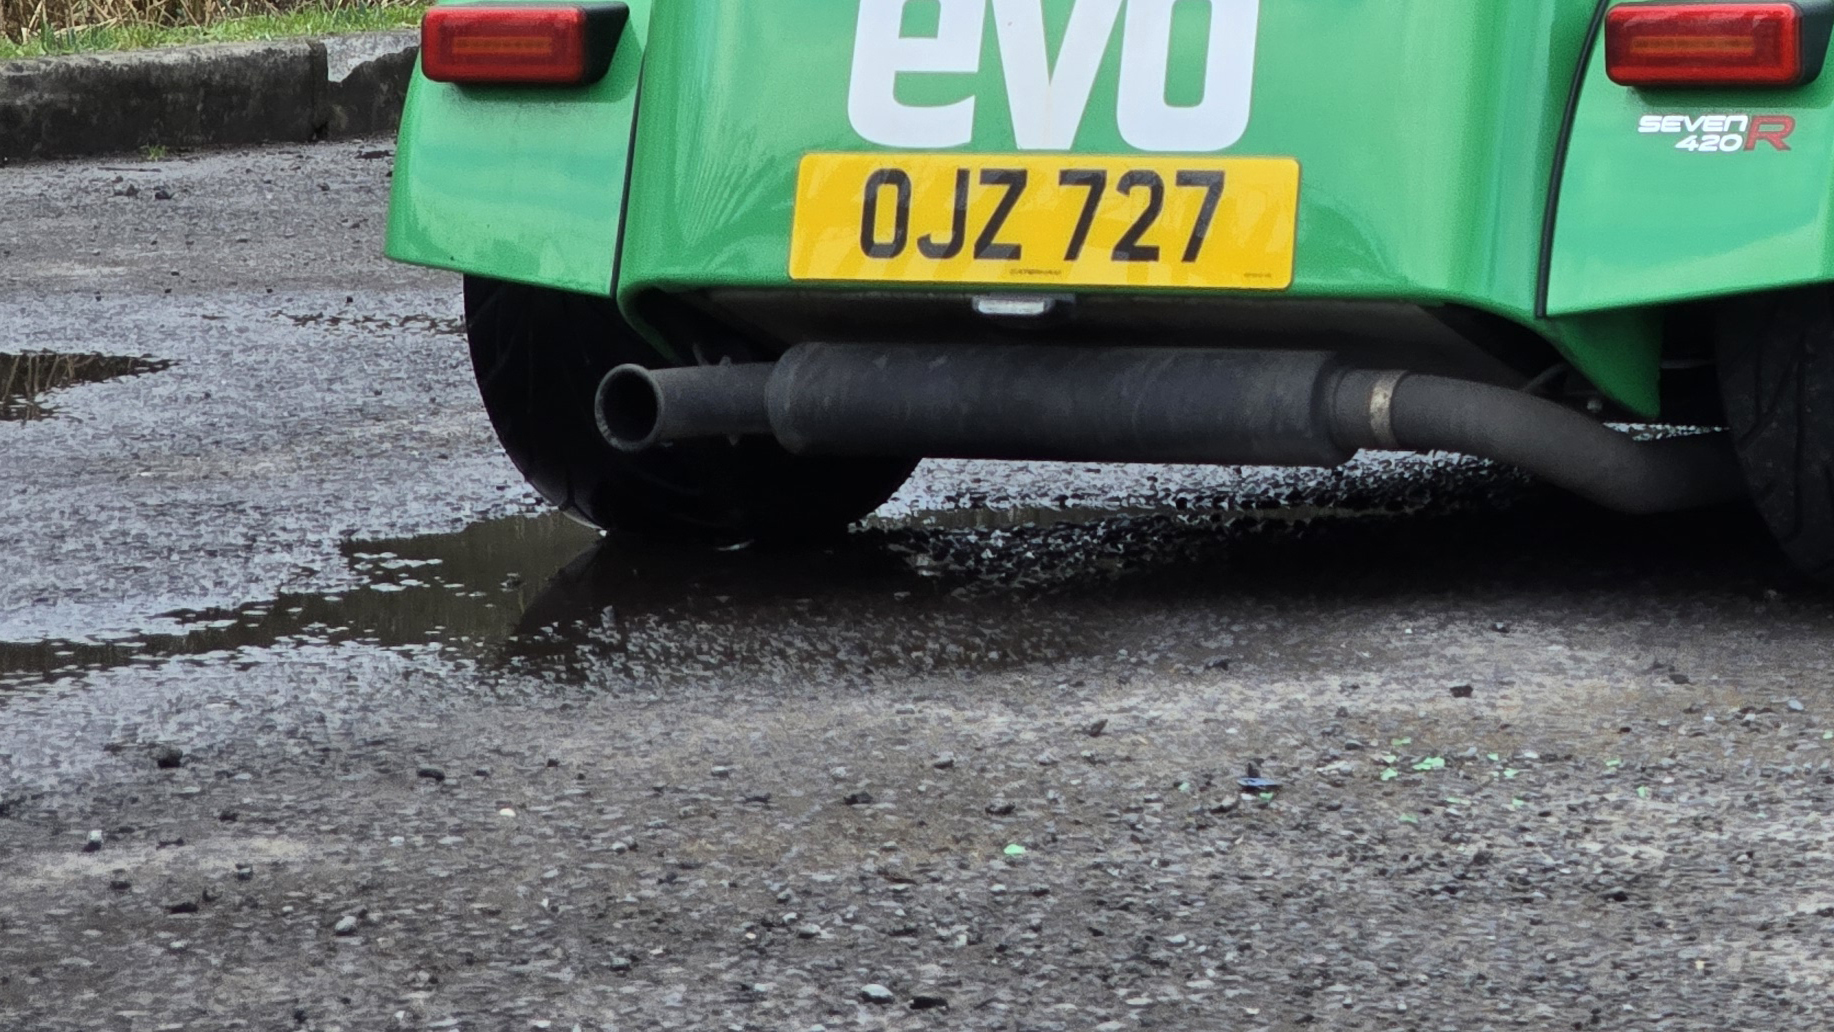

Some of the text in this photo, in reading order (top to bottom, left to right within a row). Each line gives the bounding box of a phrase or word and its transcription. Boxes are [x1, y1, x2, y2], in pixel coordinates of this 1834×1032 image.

[1637, 114, 1748, 133] SEVEN
[1674, 133, 1743, 151] 420
[859, 168, 1226, 263] OJZ 727
